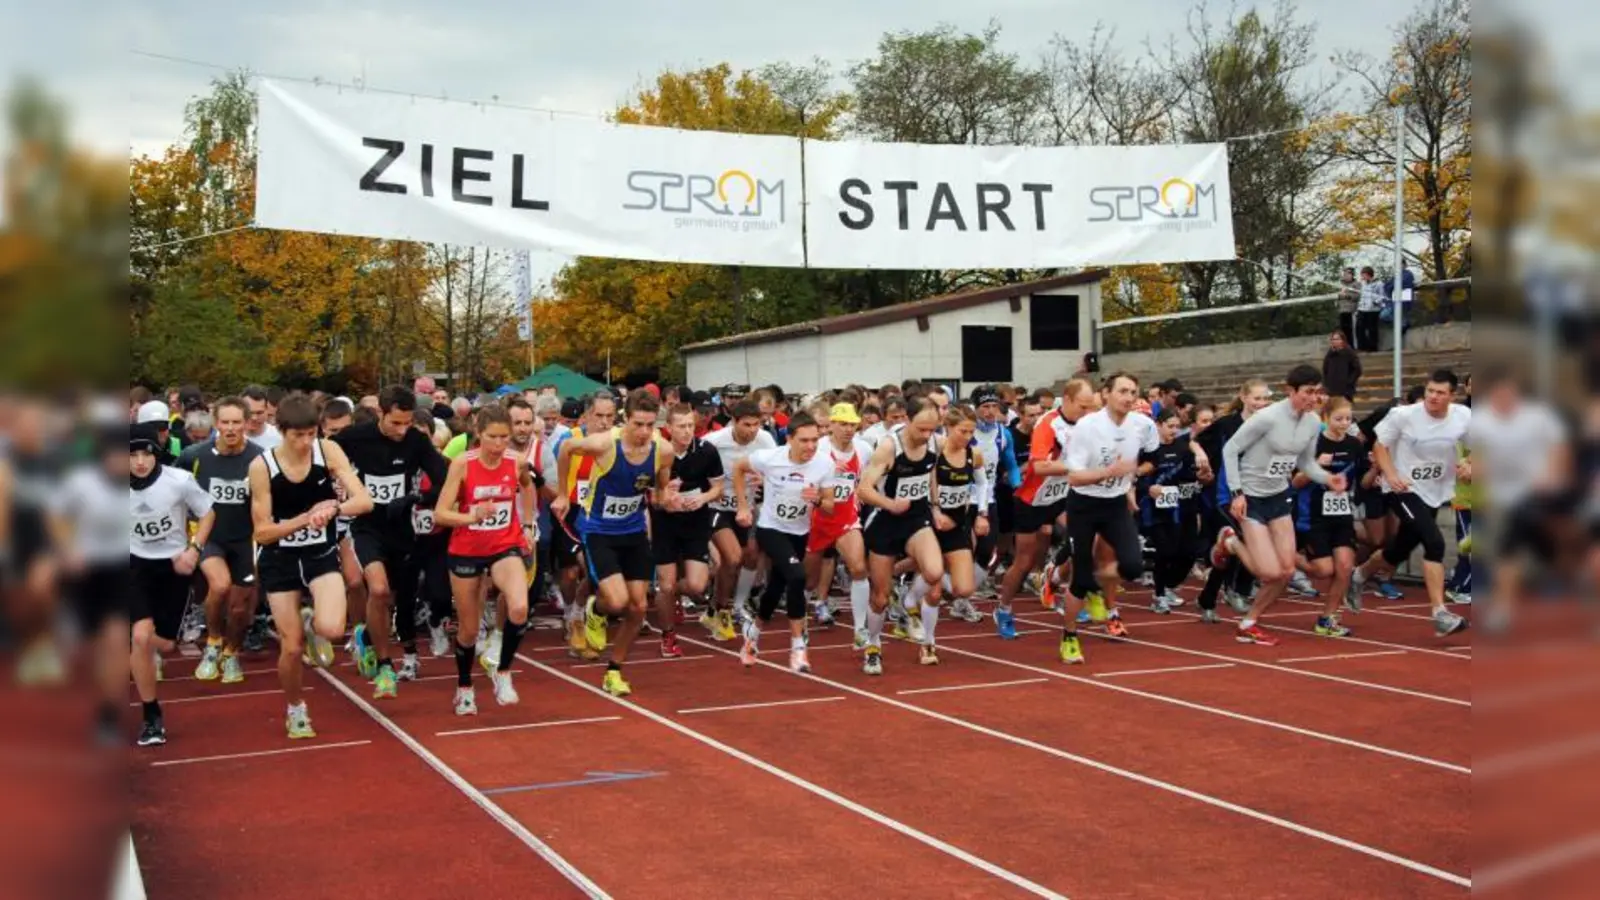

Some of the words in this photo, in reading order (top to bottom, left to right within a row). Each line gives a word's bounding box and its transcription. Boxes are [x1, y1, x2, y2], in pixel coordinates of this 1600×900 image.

[359, 137, 549, 211] ZIEL
[838, 178, 1053, 231] START
[1411, 466, 1442, 480] 628
[212, 485, 247, 501] 398
[368, 482, 401, 500] 337
[1045, 482, 1068, 497] 207
[776, 503, 807, 519] 624
[1324, 498, 1348, 512] 356
[133, 516, 173, 537] 465
